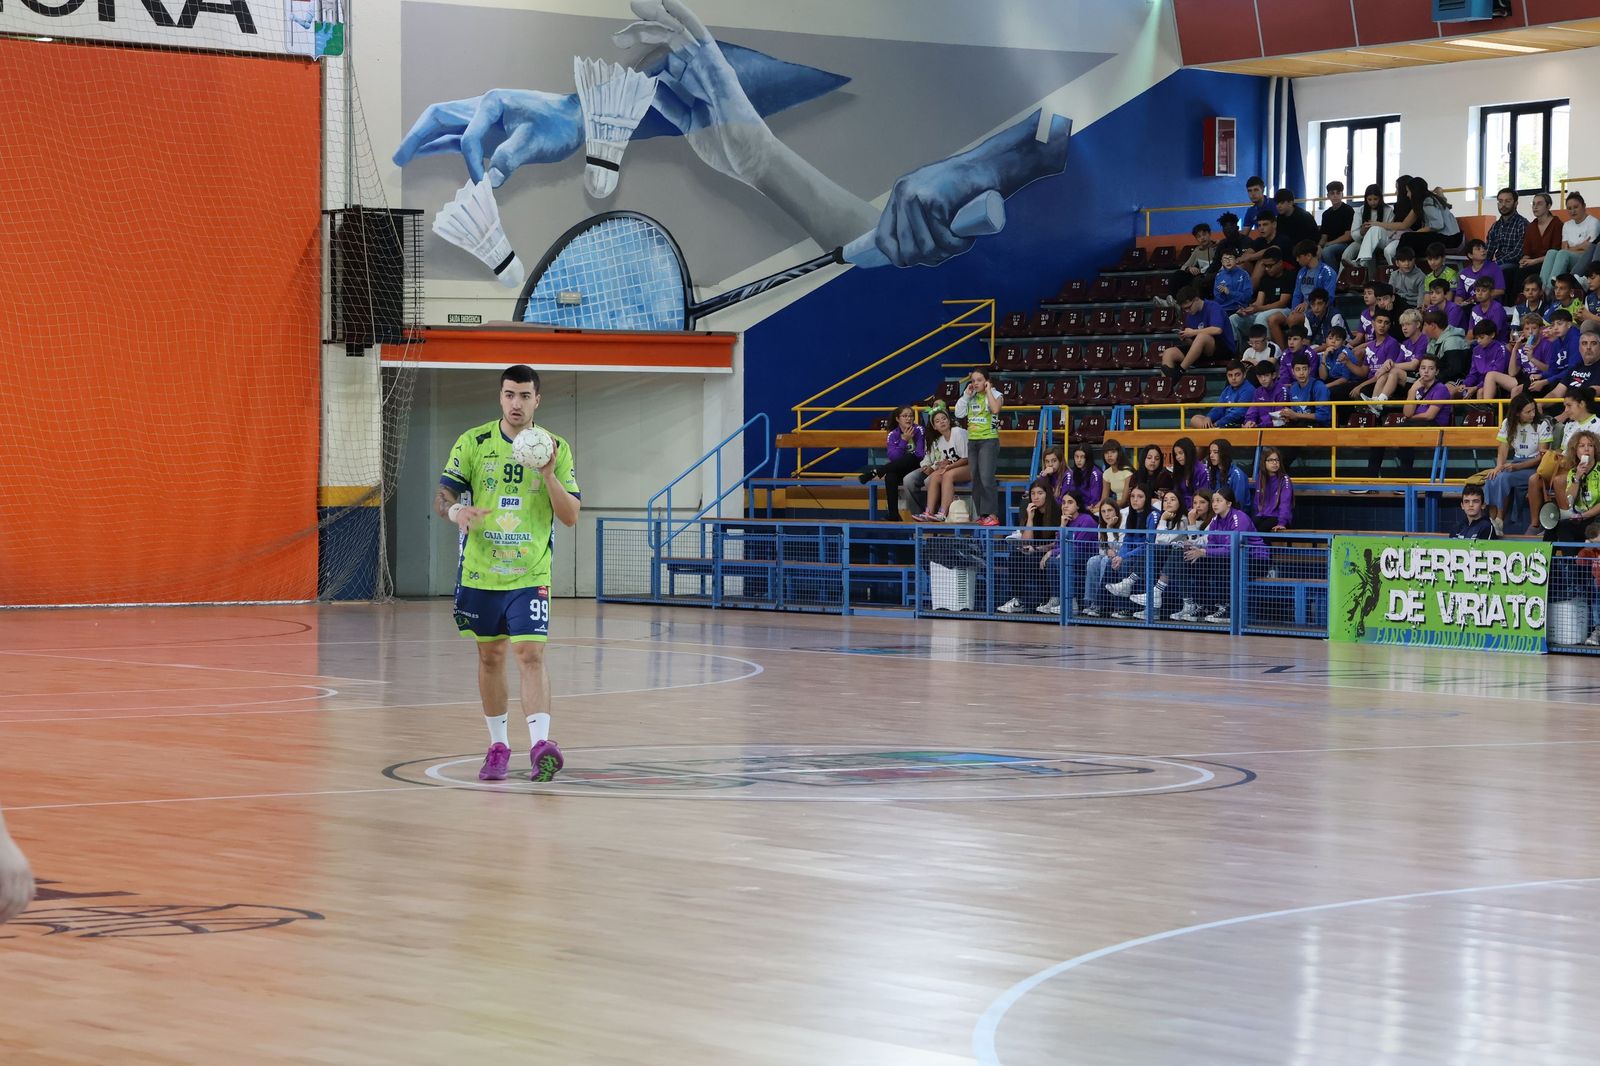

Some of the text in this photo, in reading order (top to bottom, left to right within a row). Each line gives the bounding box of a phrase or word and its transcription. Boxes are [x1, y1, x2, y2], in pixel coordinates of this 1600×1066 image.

[502, 463, 524, 484] 99
[501, 497, 520, 507] gaza
[484, 531, 531, 541] CAJA RURAL
[1380, 547, 1548, 586] GUERREROS
[530, 599, 549, 622] 99
[1385, 589, 1545, 629] DE VIRIATO
[1376, 627, 1541, 653] FANS BALONMANO ZAMORA
